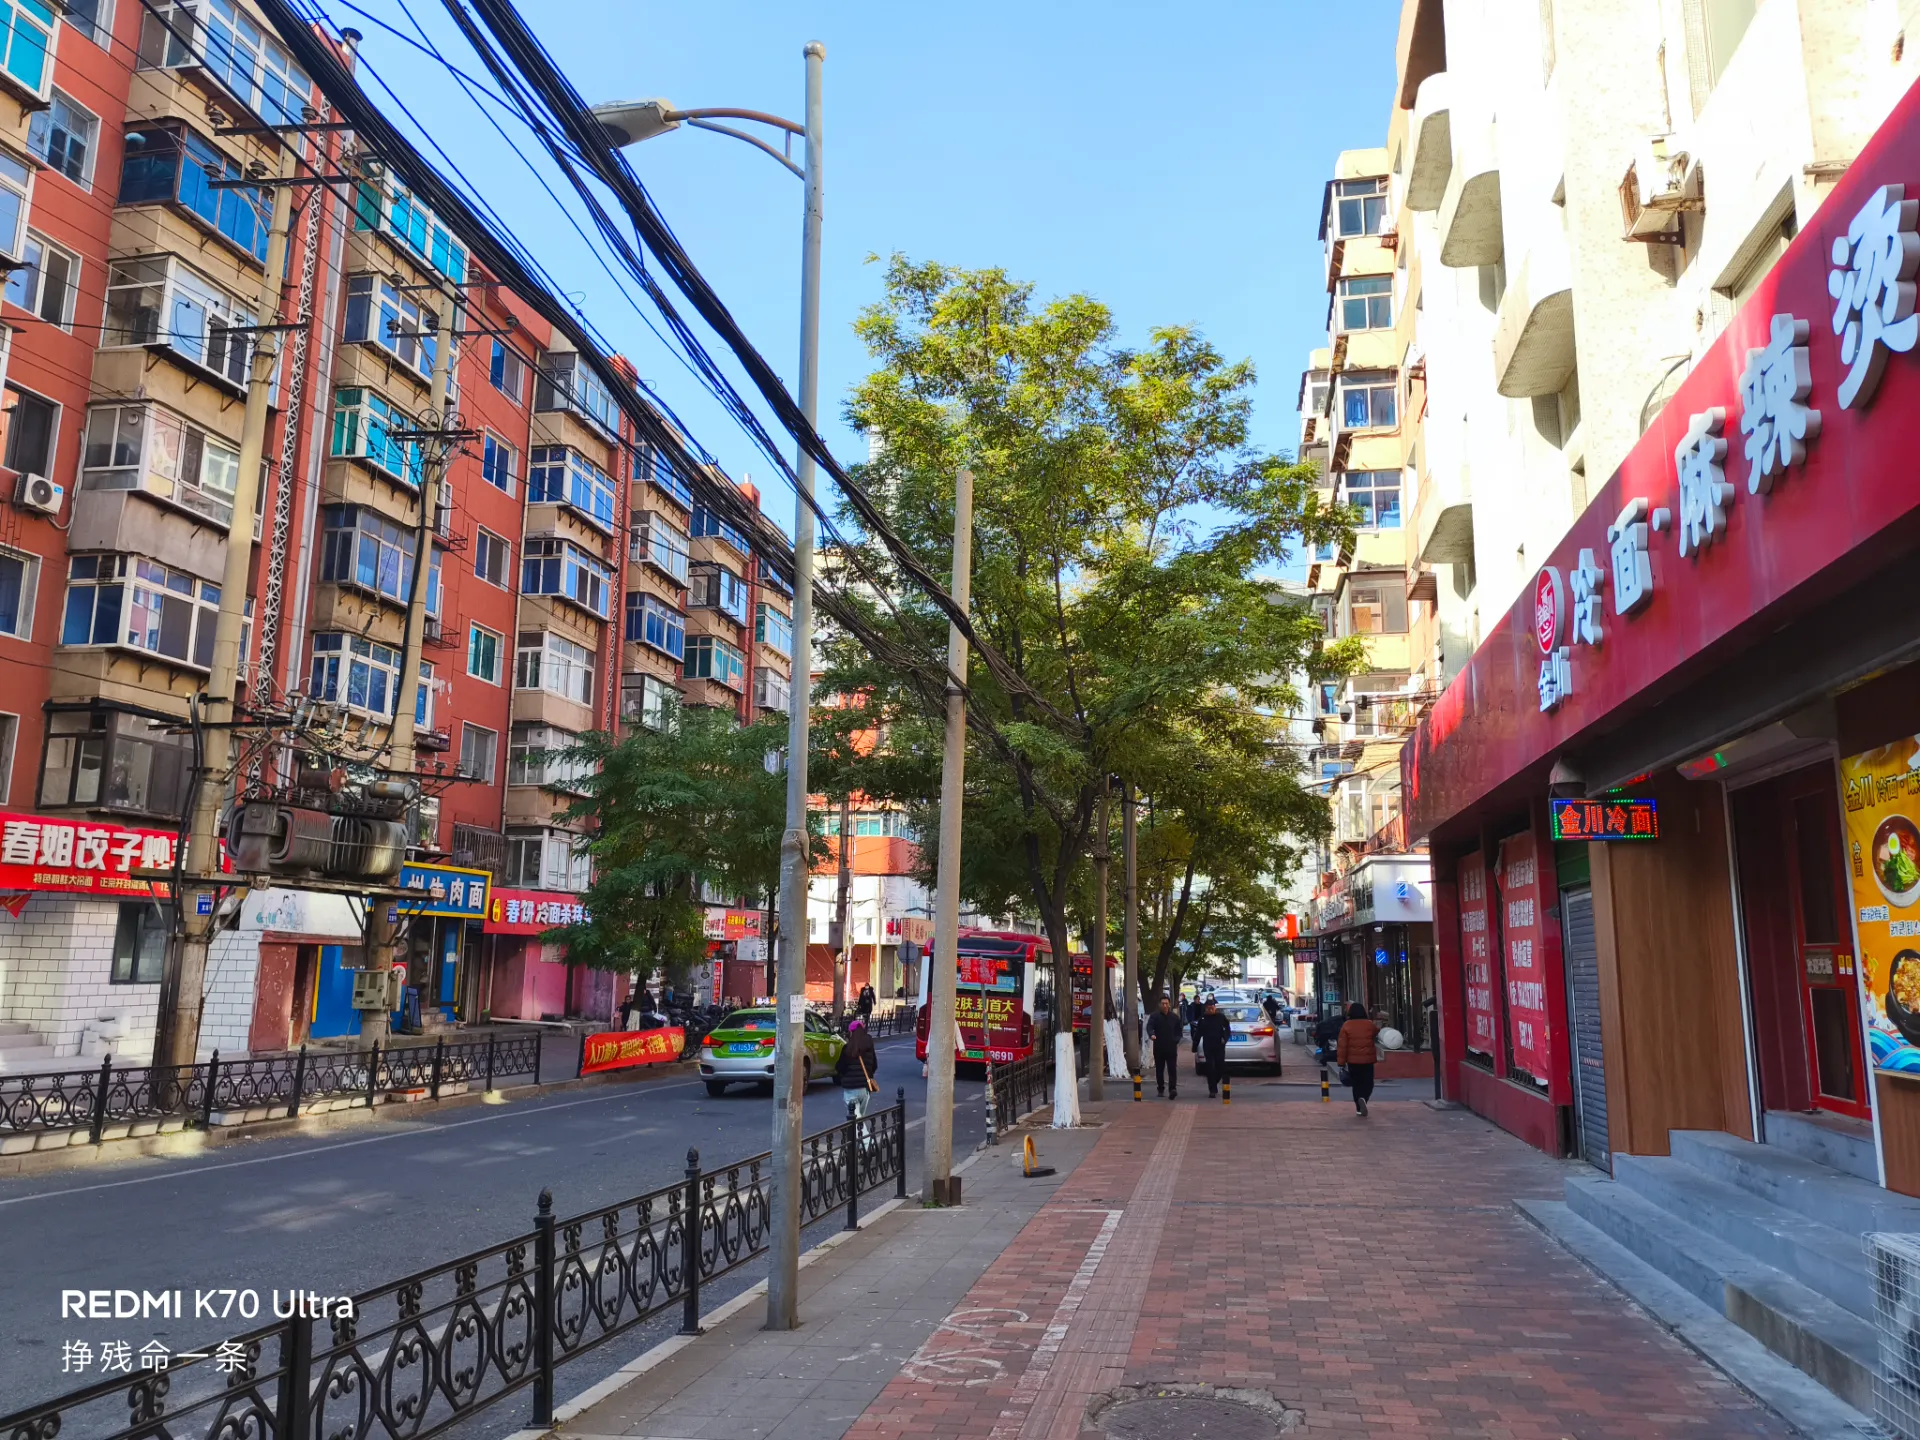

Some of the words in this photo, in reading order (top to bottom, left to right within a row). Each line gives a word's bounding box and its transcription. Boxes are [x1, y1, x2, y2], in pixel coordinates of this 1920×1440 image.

[1846, 774, 1875, 812] 金川
[1559, 804, 1651, 834] 金川冷面
